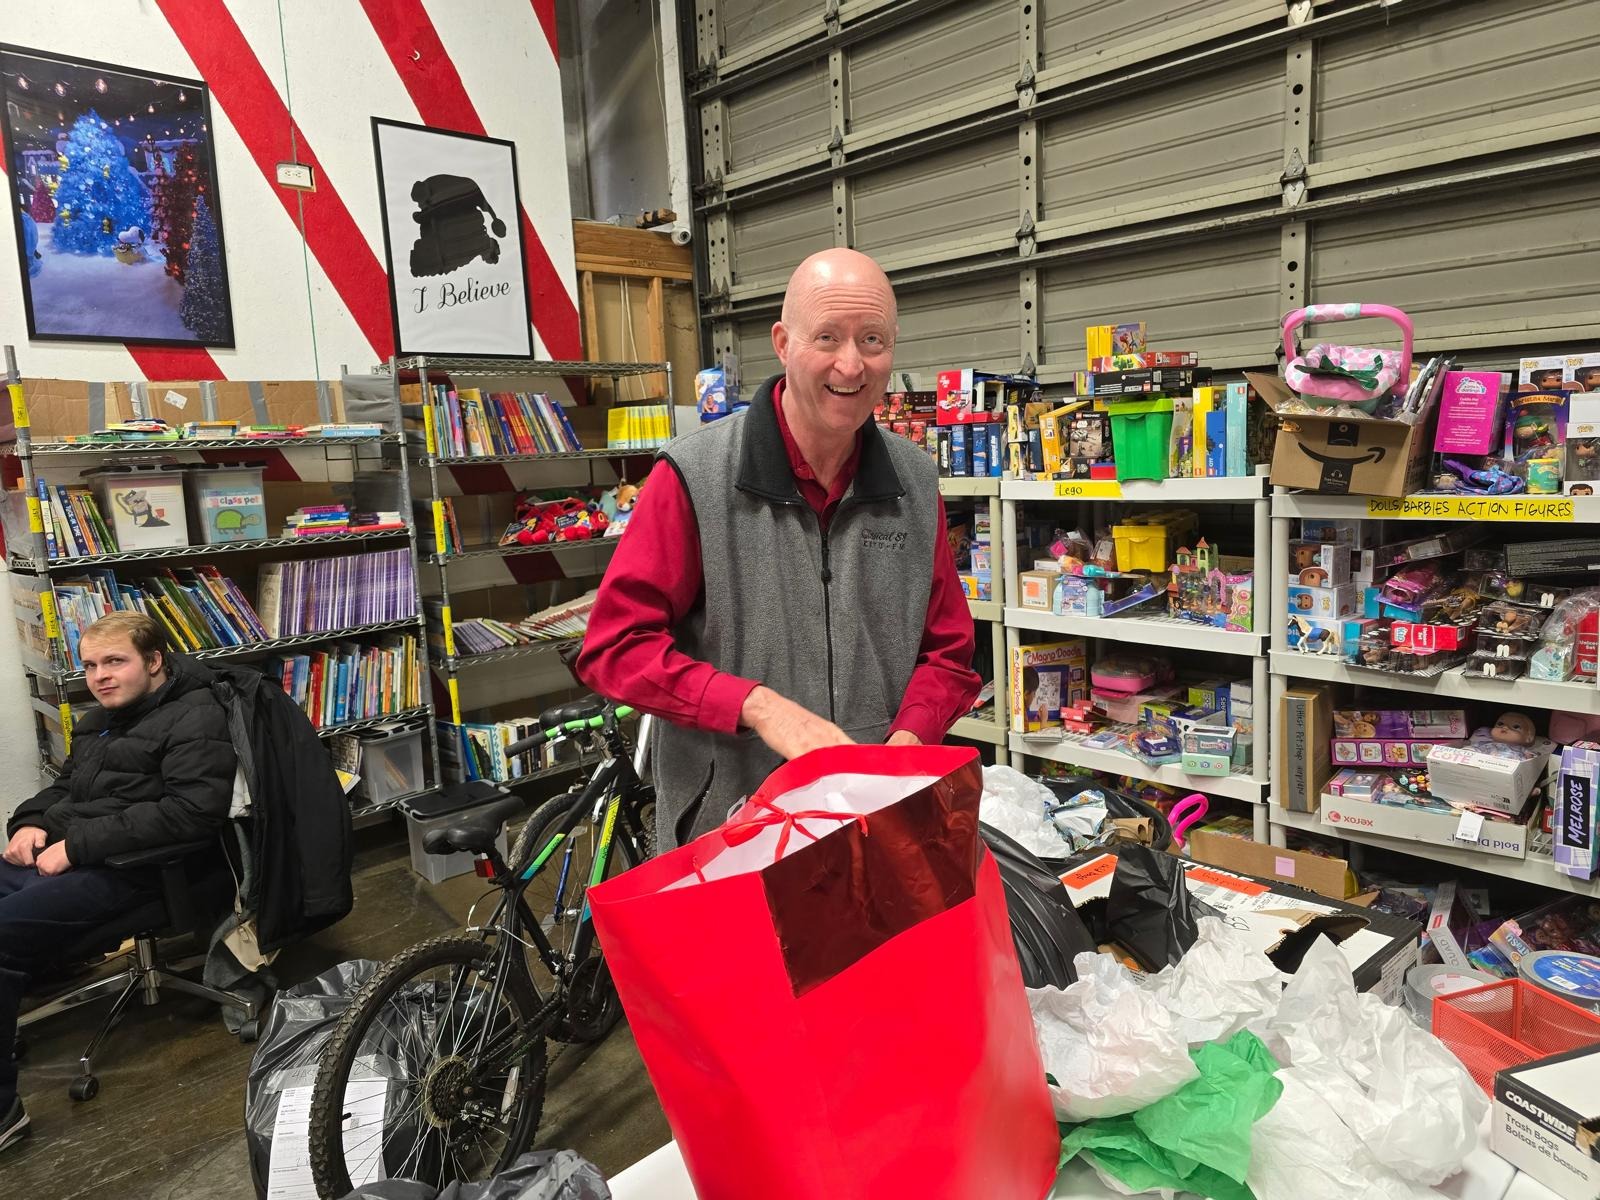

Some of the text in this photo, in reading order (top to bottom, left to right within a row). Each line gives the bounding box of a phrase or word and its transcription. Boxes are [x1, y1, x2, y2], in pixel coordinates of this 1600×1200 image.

[412, 277, 511, 314] I Believe
[1059, 484, 1082, 496] Lego
[220, 496, 242, 506] class
[1457, 501, 1509, 517] ACTION
[1514, 502, 1572, 518] FIGURES
[1027, 645, 1082, 665] Magna Doodle
[1431, 750, 1471, 764] CUTE
[1343, 815, 1374, 827] xerox
[1567, 779, 1587, 845] MELROSE
[1494, 840, 1520, 852] Bold
[1505, 1090, 1577, 1139] COASTWIDE
[1505, 1112, 1532, 1136] Trash
[1534, 1130, 1559, 1152] Bags
[1505, 1124, 1537, 1149] Bolsas
[1538, 1145, 1552, 1158] de
[1553, 1152, 1590, 1182] basura
